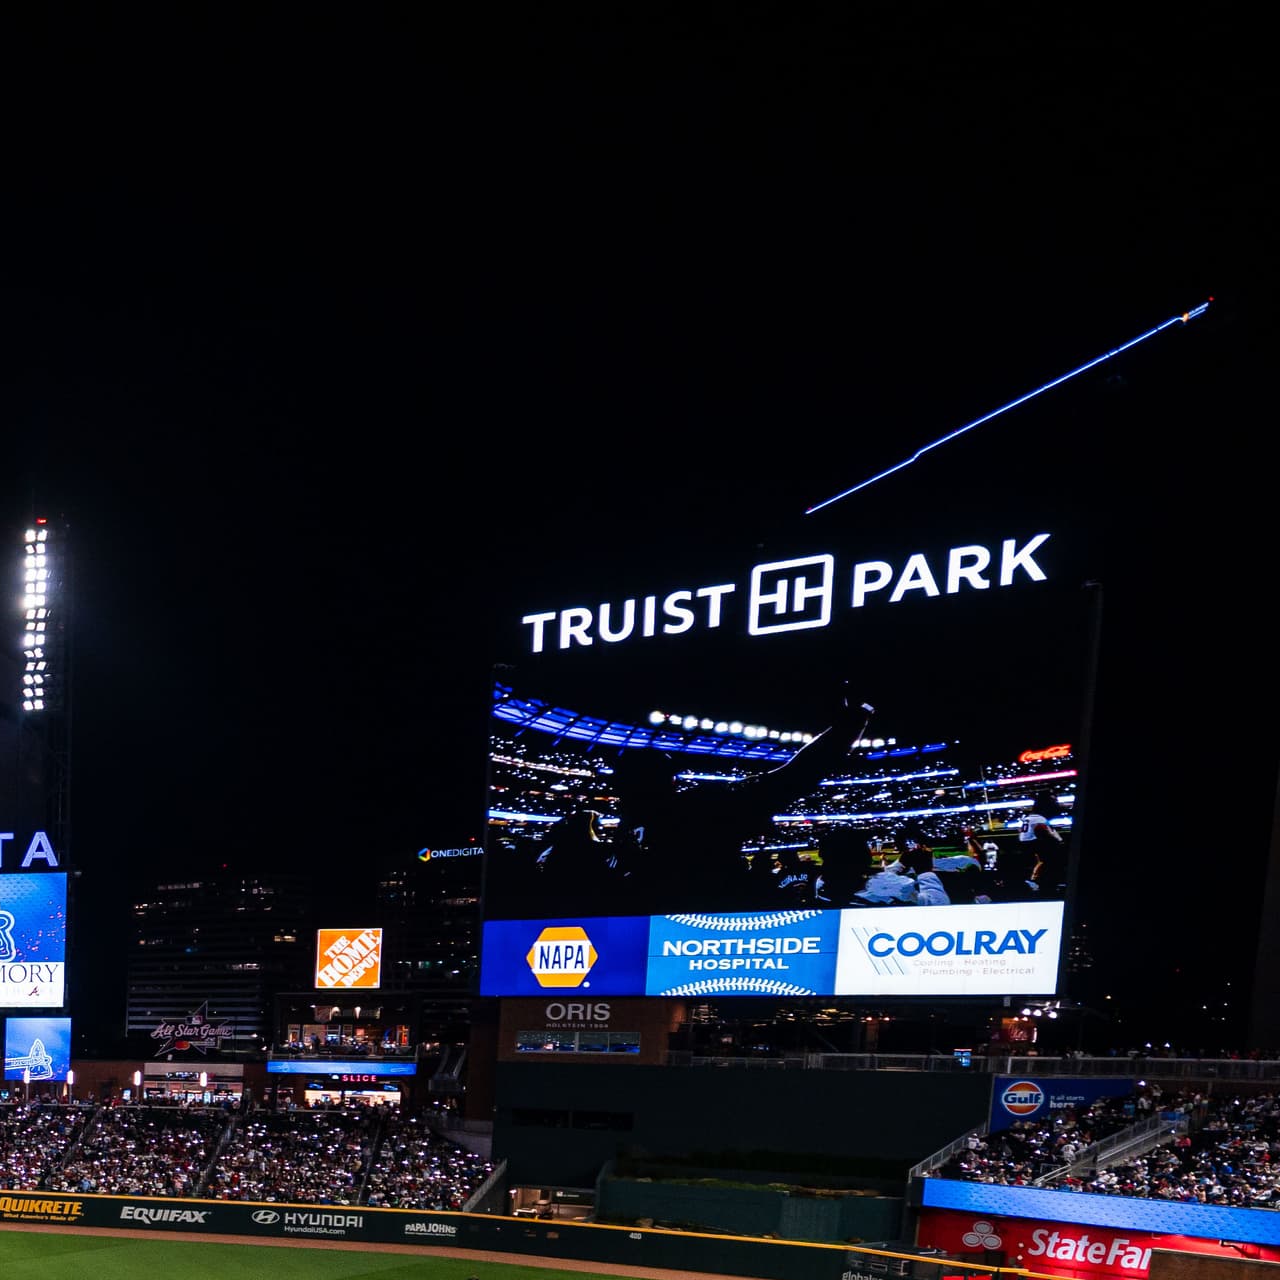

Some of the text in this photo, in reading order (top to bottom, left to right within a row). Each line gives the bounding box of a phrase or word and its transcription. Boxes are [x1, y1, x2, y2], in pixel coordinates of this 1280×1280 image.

[522, 533, 1051, 653] TRUIST PARK
[431, 847, 484, 858] ONEDIGITA
[324, 935, 351, 959] THE
[663, 937, 821, 957] NORTHSIDE
[867, 928, 1047, 958] COOLRAY
[319, 930, 380, 986] HOME
[539, 944, 586, 969] NAPA
[689, 957, 789, 971] HOSPITAL
[341, 951, 379, 986] DEPOT
[546, 1002, 611, 1020] ORIS
[175, 1023, 199, 1037] Star
[199, 1024, 234, 1038] Game
[342, 1074, 377, 1082] SLICE
[1003, 1092, 1043, 1106] Gulf
[120, 1205, 209, 1224] EQUIFAX
[284, 1212, 363, 1229] HYUNDAI
[284, 1226, 346, 1236] HyundaiUSA.com
[405, 1223, 428, 1234] PAPA
[1028, 1229, 1152, 1271] State Far
